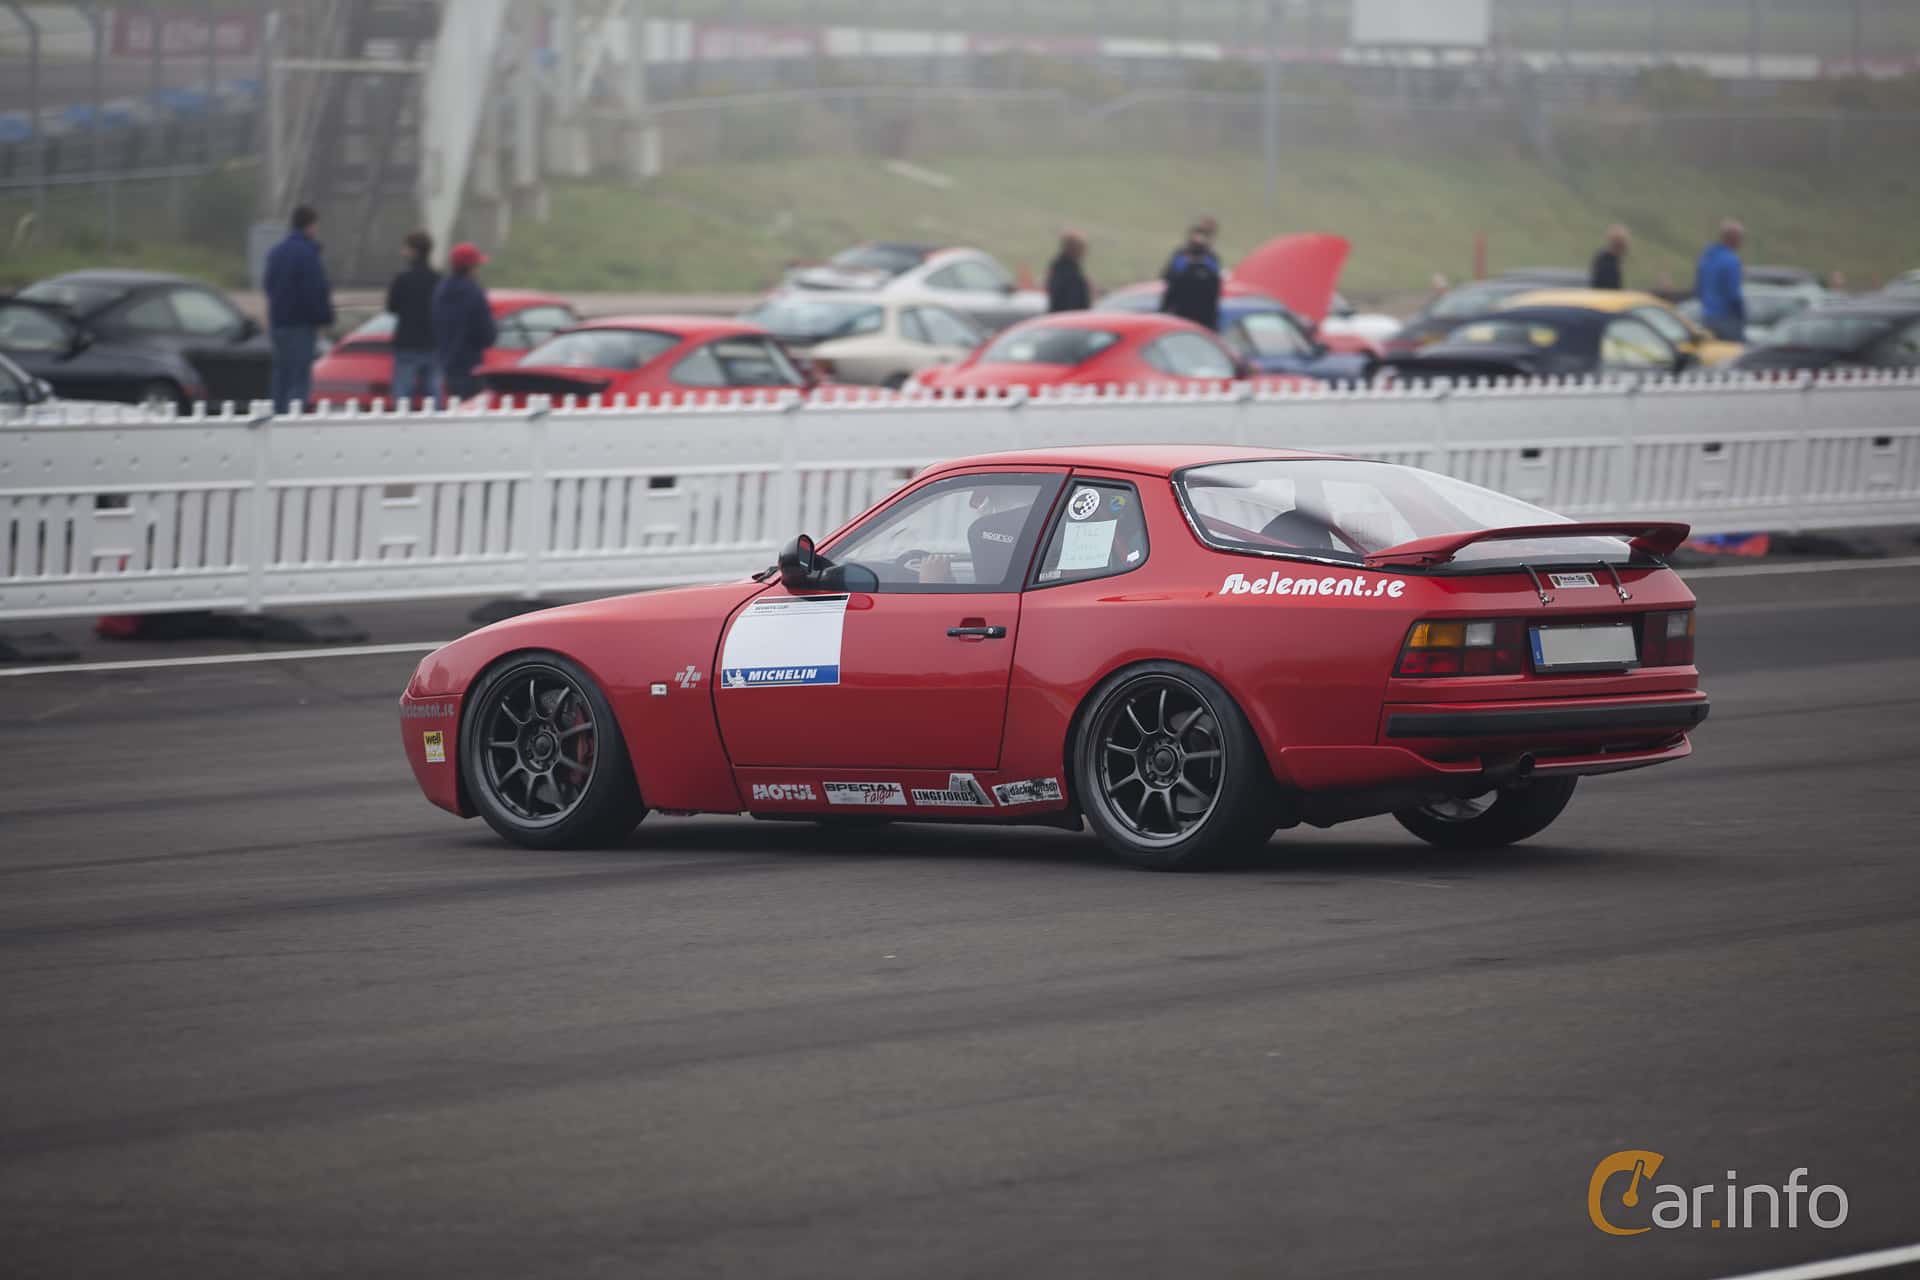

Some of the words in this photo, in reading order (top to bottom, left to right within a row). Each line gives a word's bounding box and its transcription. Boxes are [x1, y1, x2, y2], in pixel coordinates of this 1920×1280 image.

[748, 668, 818, 681] MICHELIN
[752, 783, 817, 800] MOTUL
[824, 783, 901, 792] SPECIAL
